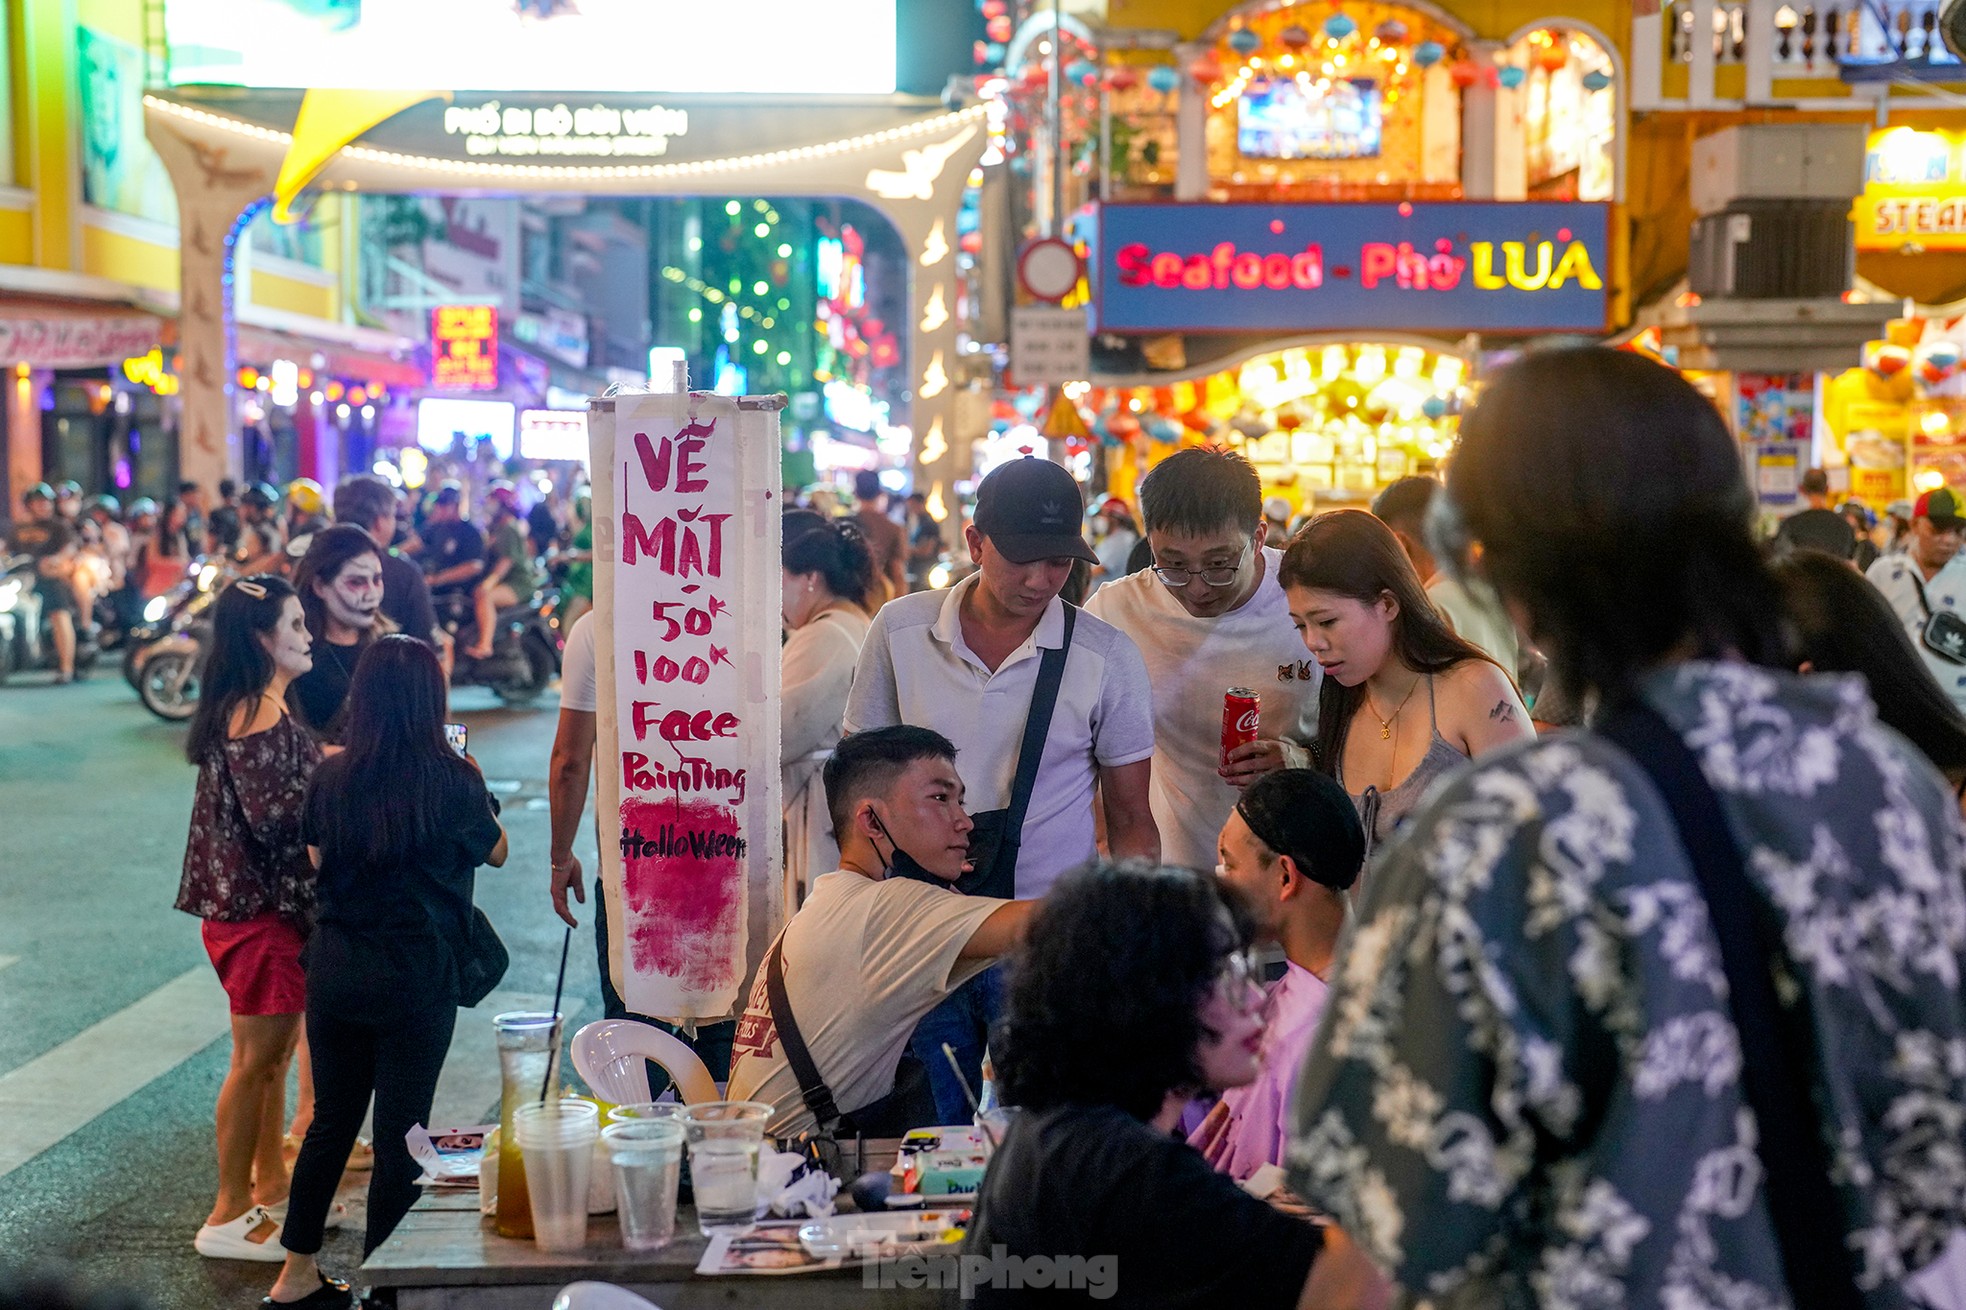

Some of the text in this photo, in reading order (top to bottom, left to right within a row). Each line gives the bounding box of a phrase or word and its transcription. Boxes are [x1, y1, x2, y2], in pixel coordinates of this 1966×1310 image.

[1116, 241, 1324, 290] Seafood
[622, 504, 734, 594] MẶT
[632, 700, 741, 743] Face
